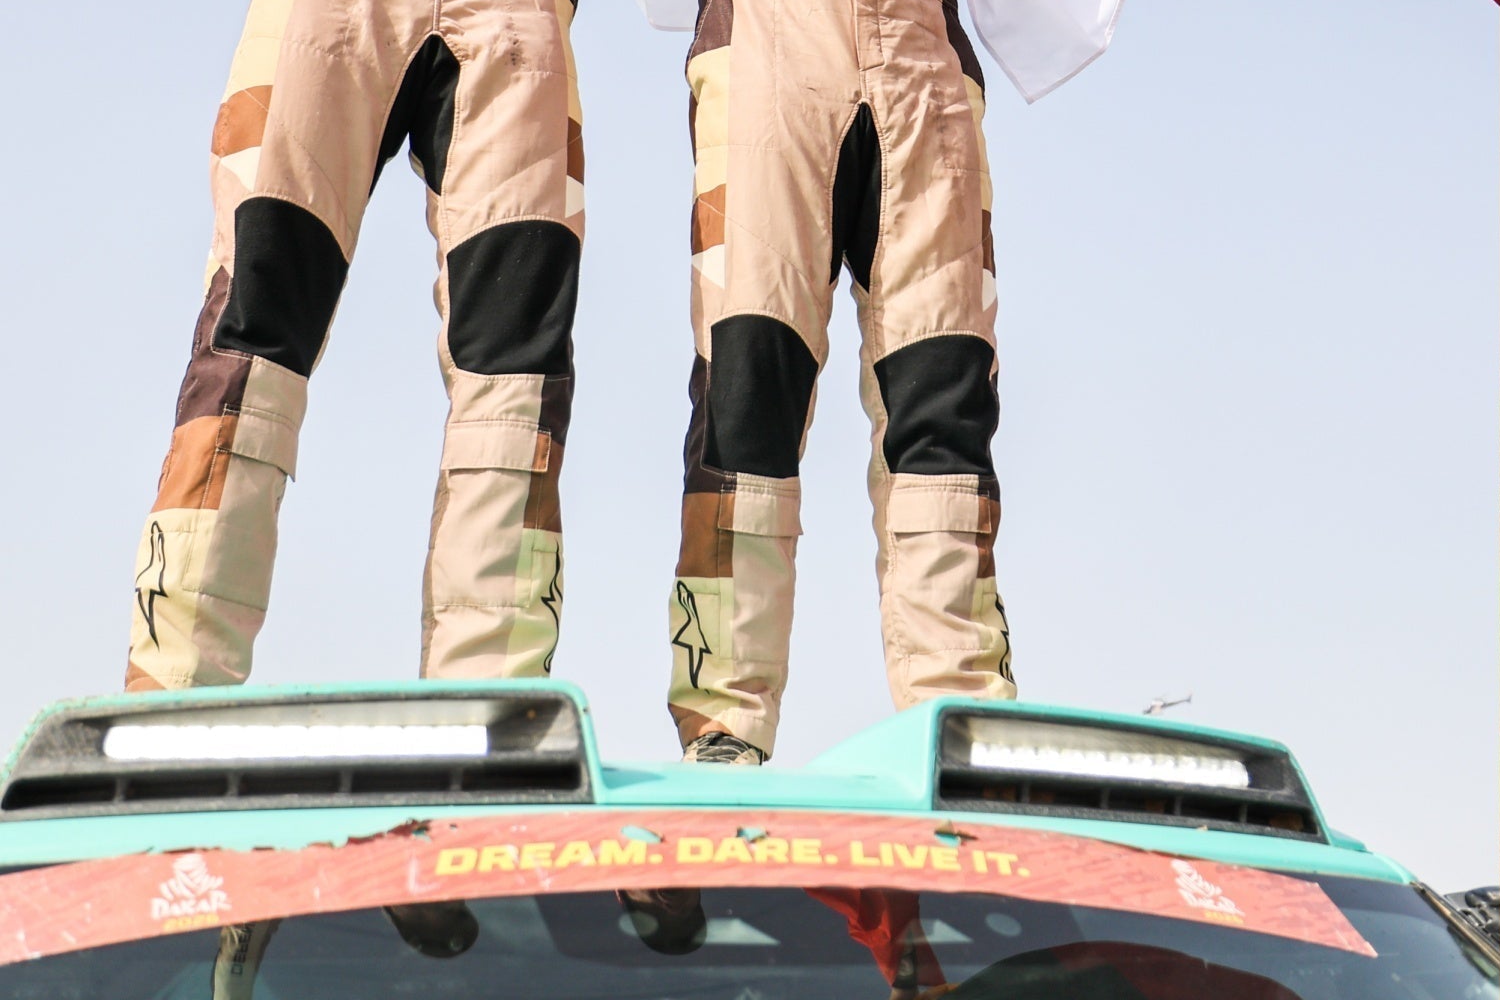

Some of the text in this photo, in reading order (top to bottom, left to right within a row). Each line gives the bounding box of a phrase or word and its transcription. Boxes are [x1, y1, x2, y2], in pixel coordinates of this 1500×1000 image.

[434, 837, 1031, 877] DREAM. DARE. LIVE IT.
[151, 890, 232, 920] DAKAR
